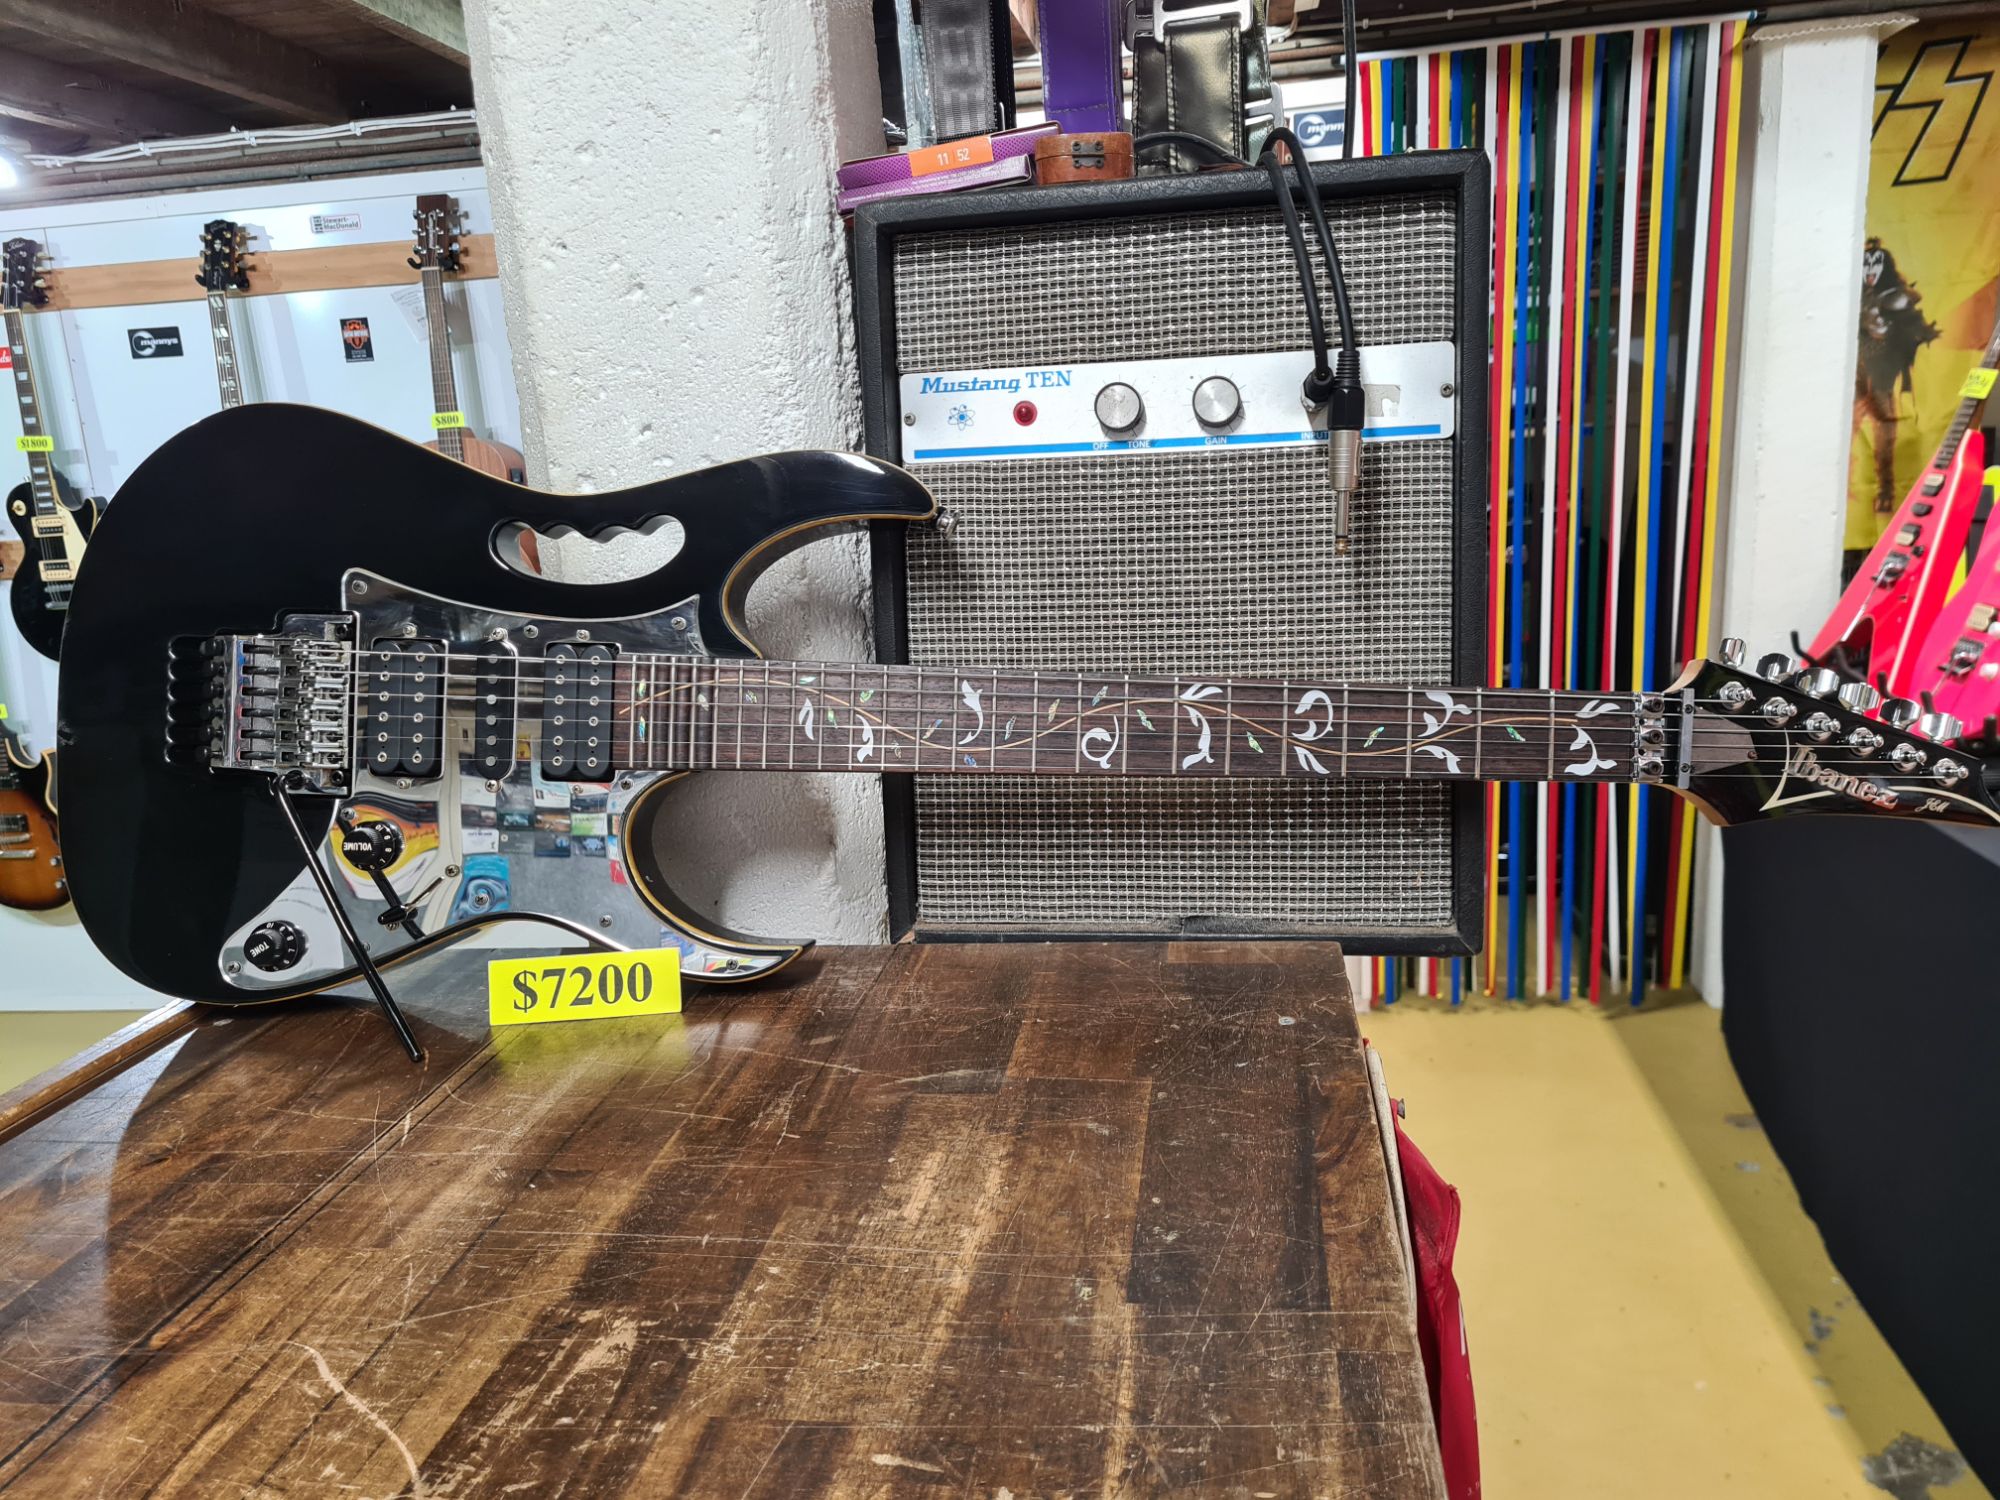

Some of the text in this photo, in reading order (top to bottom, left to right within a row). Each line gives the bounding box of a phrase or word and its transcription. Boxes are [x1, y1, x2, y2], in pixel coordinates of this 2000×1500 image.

[936, 147, 971, 167] 11 52
[920, 370, 1072, 394] Mustang TEN
[435, 414, 460, 426] $800
[20, 438, 49, 449] $1800
[1128, 441, 1150, 449] TONE
[1205, 437, 1227, 445] GAIN
[1788, 744, 1900, 810] Ibanez
[343, 842, 373, 851] VOLUME
[249, 941, 270, 958] TONE
[512, 962, 653, 1013] $7200
